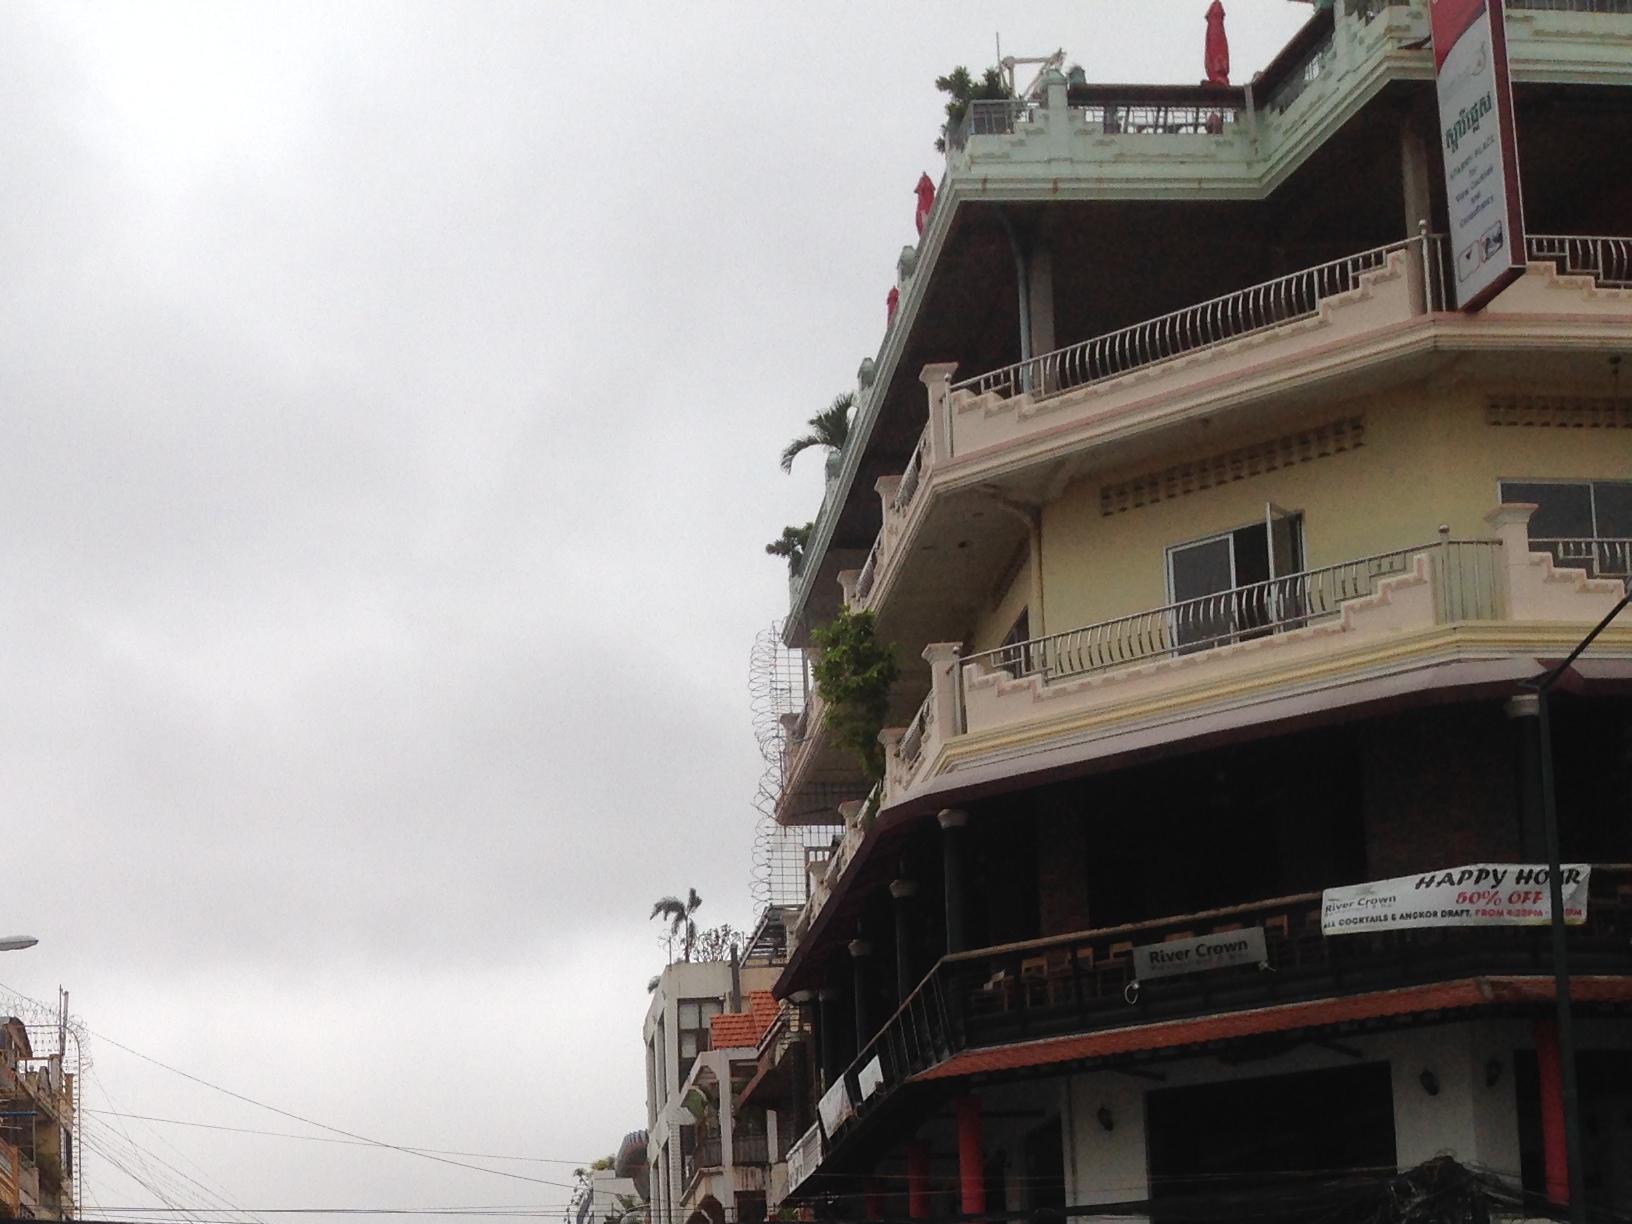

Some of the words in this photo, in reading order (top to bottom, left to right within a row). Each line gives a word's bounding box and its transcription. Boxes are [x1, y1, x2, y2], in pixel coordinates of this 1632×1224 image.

[1415, 868, 1508, 889] HAPPY
[1515, 868, 1581, 885] HOR
[1325, 901, 1355, 914] River
[1357, 895, 1396, 908] Crown
[1455, 890, 1502, 907] 50%
[1508, 891, 1543, 904] OFF
[1338, 914, 1388, 926] COCKTAILS
[1399, 910, 1438, 920] ANGKOR
[1475, 908, 1504, 917] FROM
[1149, 949, 1191, 964] River
[1195, 940, 1248, 958] Crown
